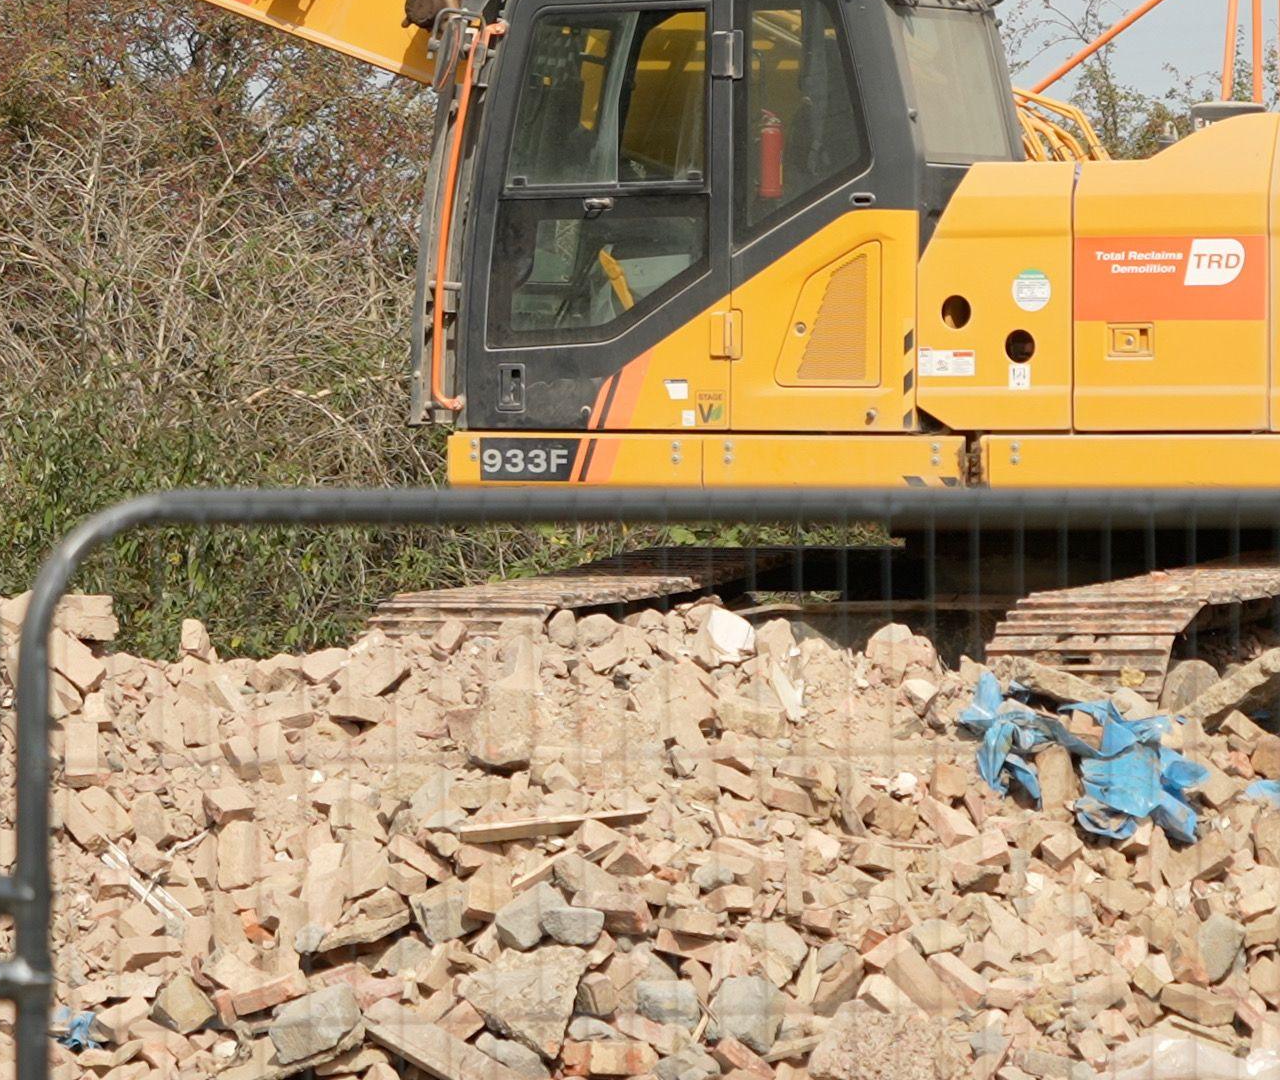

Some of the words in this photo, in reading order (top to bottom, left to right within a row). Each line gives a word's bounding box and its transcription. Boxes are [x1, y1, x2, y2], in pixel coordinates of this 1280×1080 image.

[1095, 251, 1125, 261] Total
[1128, 251, 1184, 261] Reclaims
[1193, 253, 1241, 269] TRD
[1111, 264, 1176, 274] Demolition
[698, 393, 723, 401] STAGE
[482, 448, 569, 473] 933F
